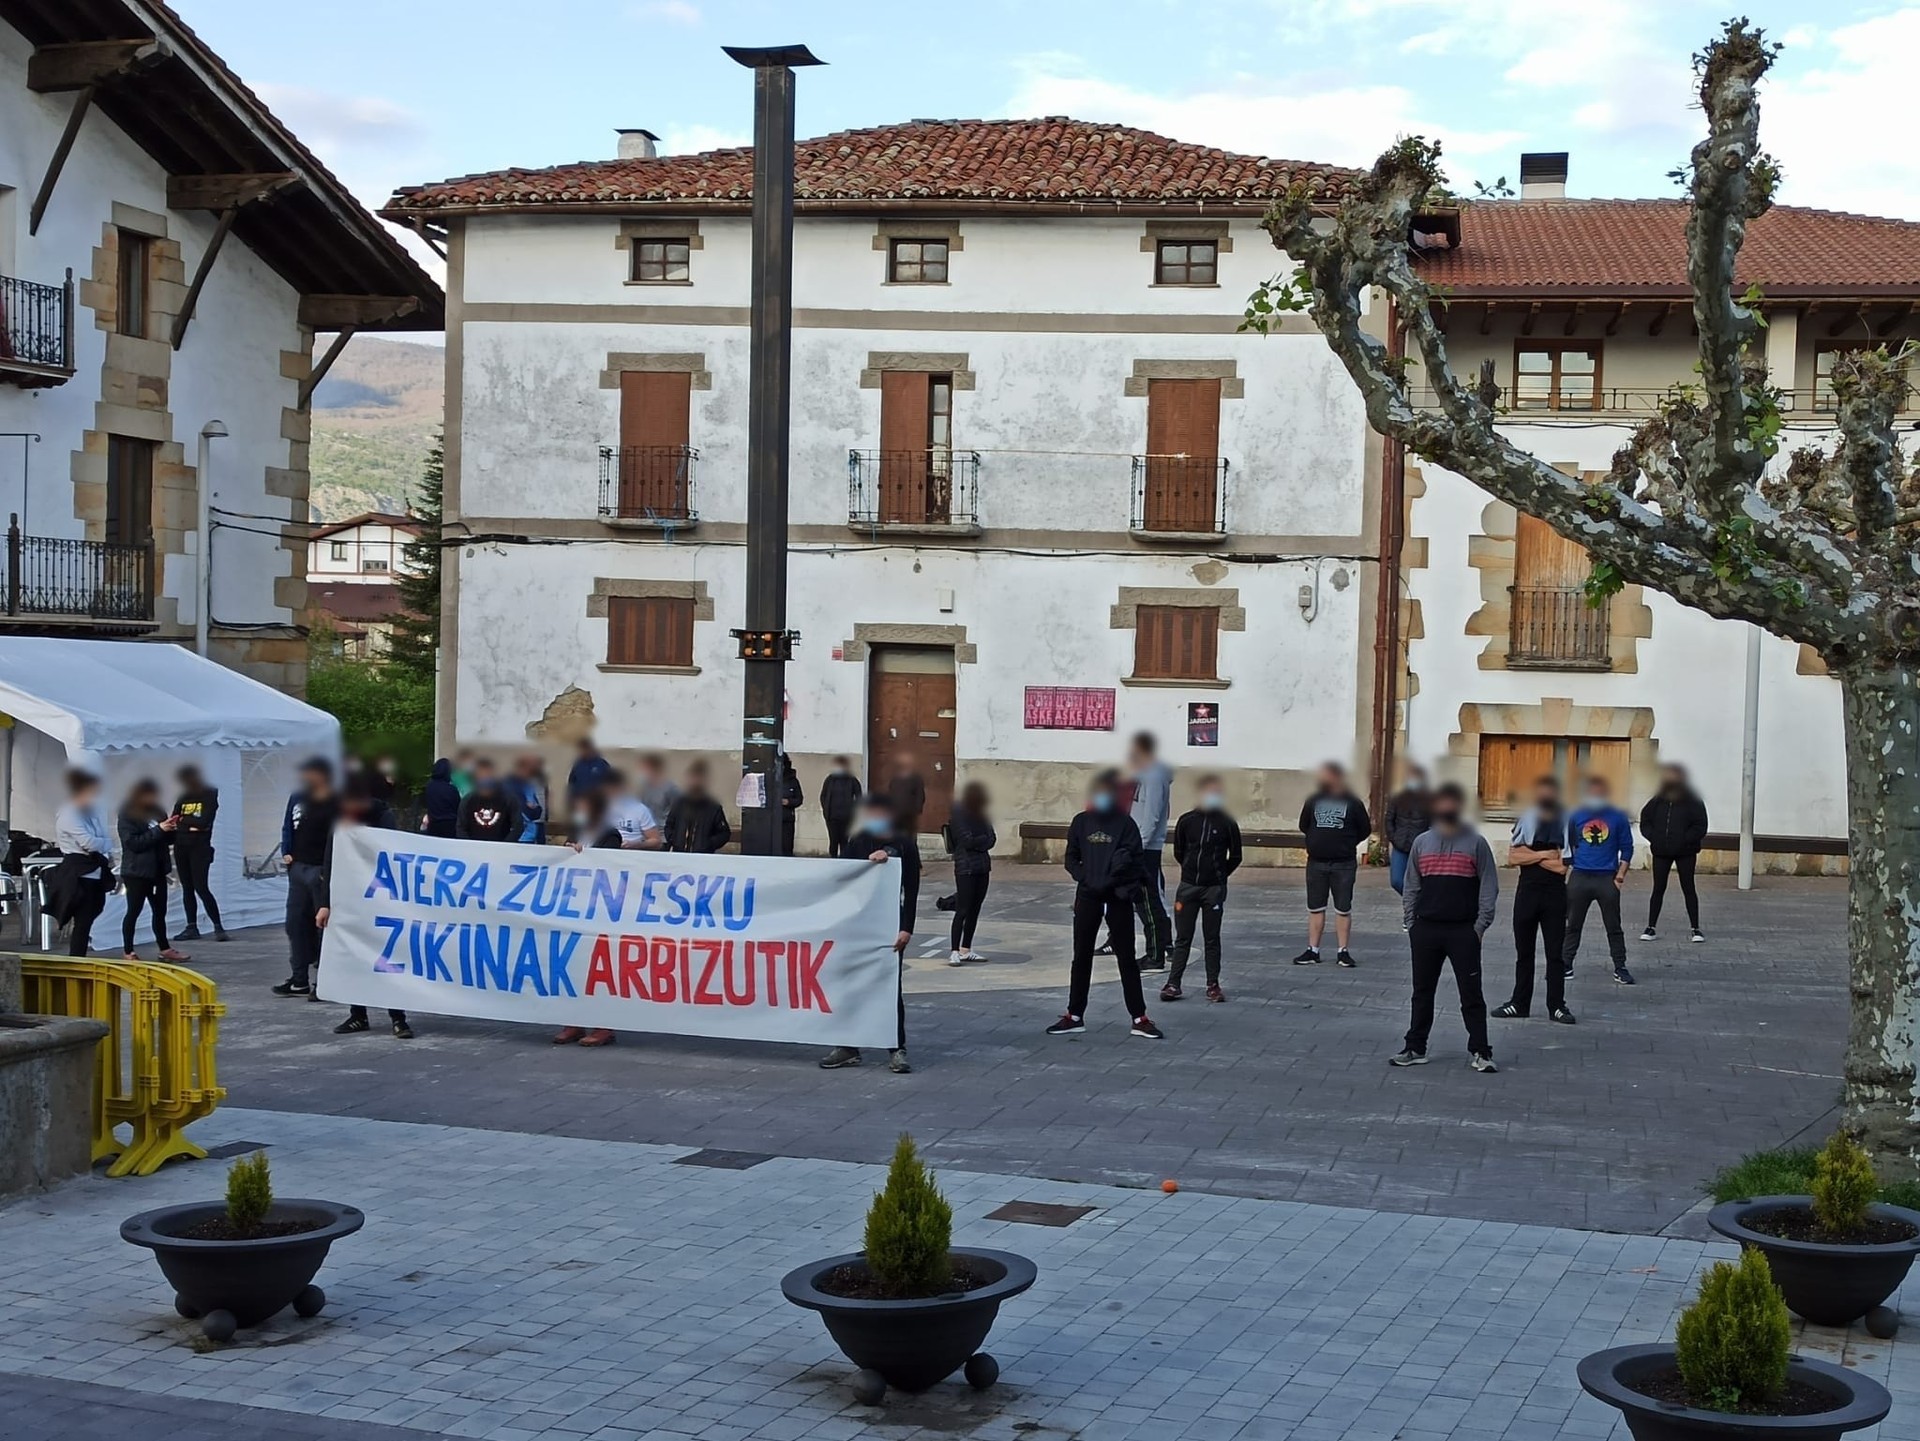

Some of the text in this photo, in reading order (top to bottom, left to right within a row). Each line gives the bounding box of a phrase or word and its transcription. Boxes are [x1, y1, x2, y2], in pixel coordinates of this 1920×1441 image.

[364, 851, 756, 932] ATERA ZUEN ESKU
[373, 916, 834, 1015] ZIKINAK ARBIZUTIK
